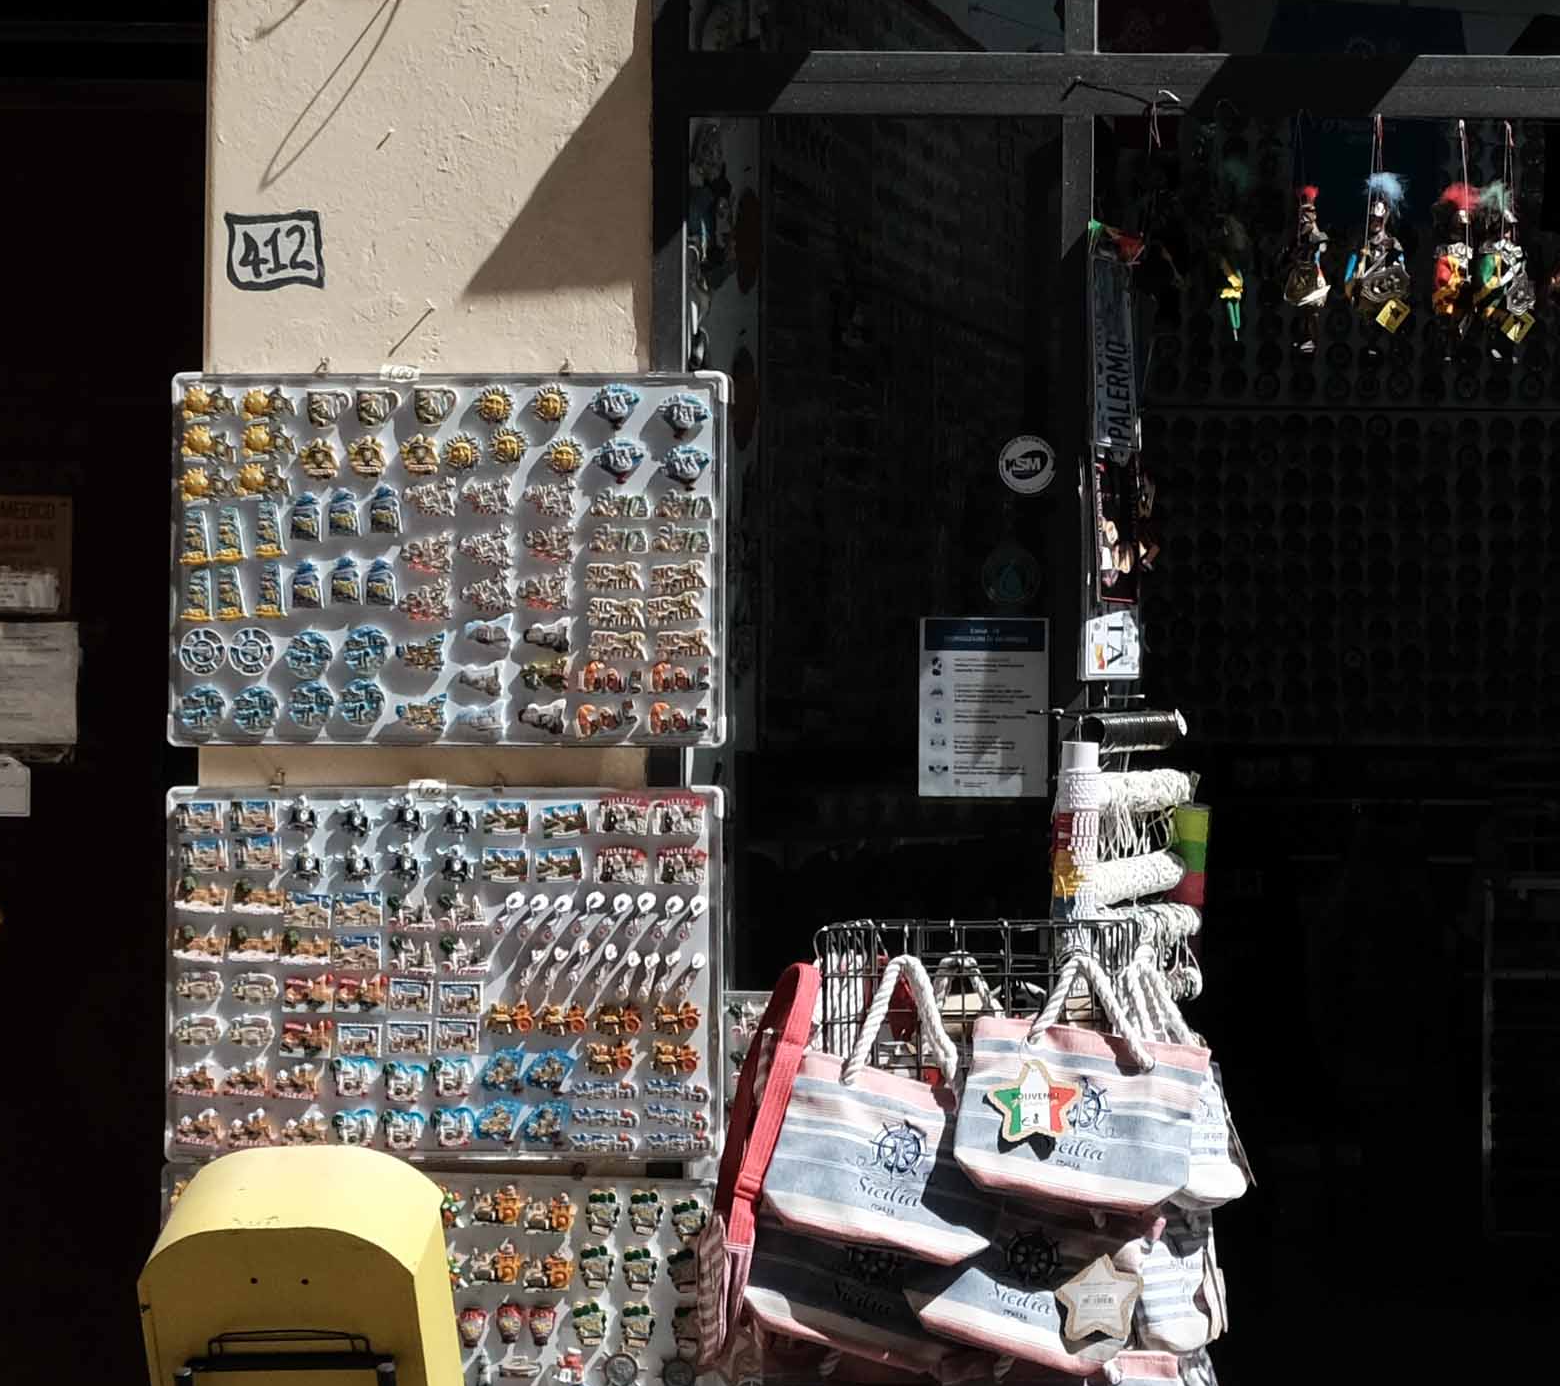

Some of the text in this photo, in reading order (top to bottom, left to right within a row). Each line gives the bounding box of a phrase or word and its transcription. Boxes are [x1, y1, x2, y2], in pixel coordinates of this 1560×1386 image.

[238, 224, 315, 279] 412
[1104, 340, 1131, 442] PALERMO
[854, 1176, 920, 1207] Sicilia
[988, 1282, 1051, 1315] Sicilia
